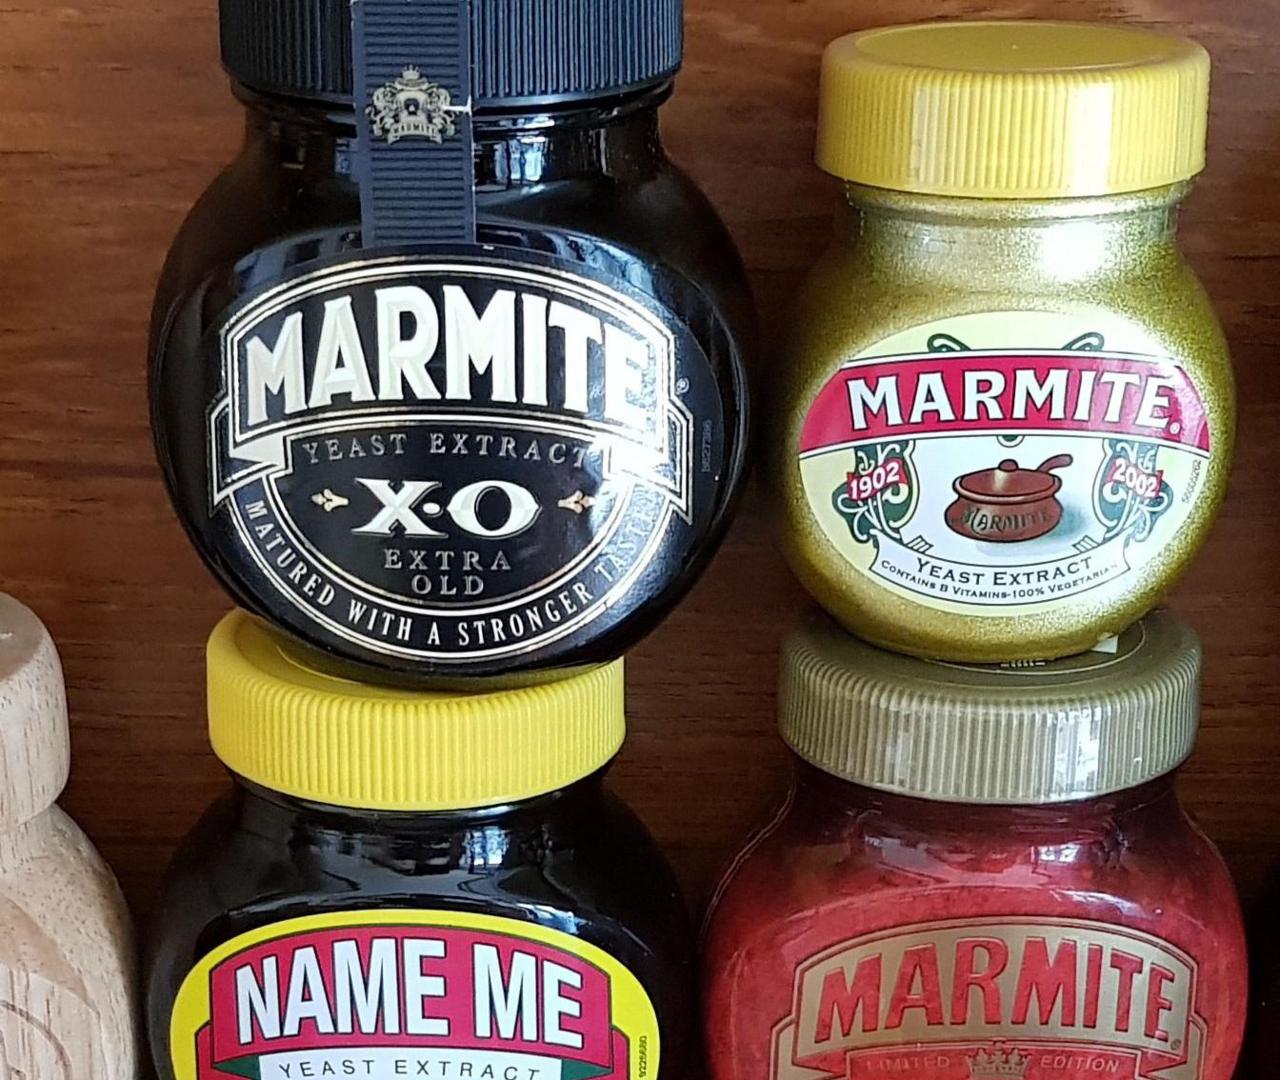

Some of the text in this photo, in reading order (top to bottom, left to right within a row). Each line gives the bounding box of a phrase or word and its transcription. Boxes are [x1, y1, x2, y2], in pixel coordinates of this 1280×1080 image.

[244, 284, 657, 428] MARMITE
[846, 368, 1175, 433] MARMITE
[303, 432, 586, 469] YEAST EXTRACT
[849, 462, 901, 500] 1902
[1113, 459, 1158, 499] 2002
[244, 500, 595, 647] MATURED WITH A STRONGER
[385, 548, 512, 571] EXTRA
[880, 560, 949, 592] CONTAINS B
[917, 556, 1093, 587] YEAST EXTRACT
[410, 573, 485, 596] OLD
[235, 937, 584, 1050] NAME ME
[814, 937, 1176, 1044] MARMITE
[279, 1059, 375, 1079] YEAST
[1040, 1054, 1121, 1073] EDITION
